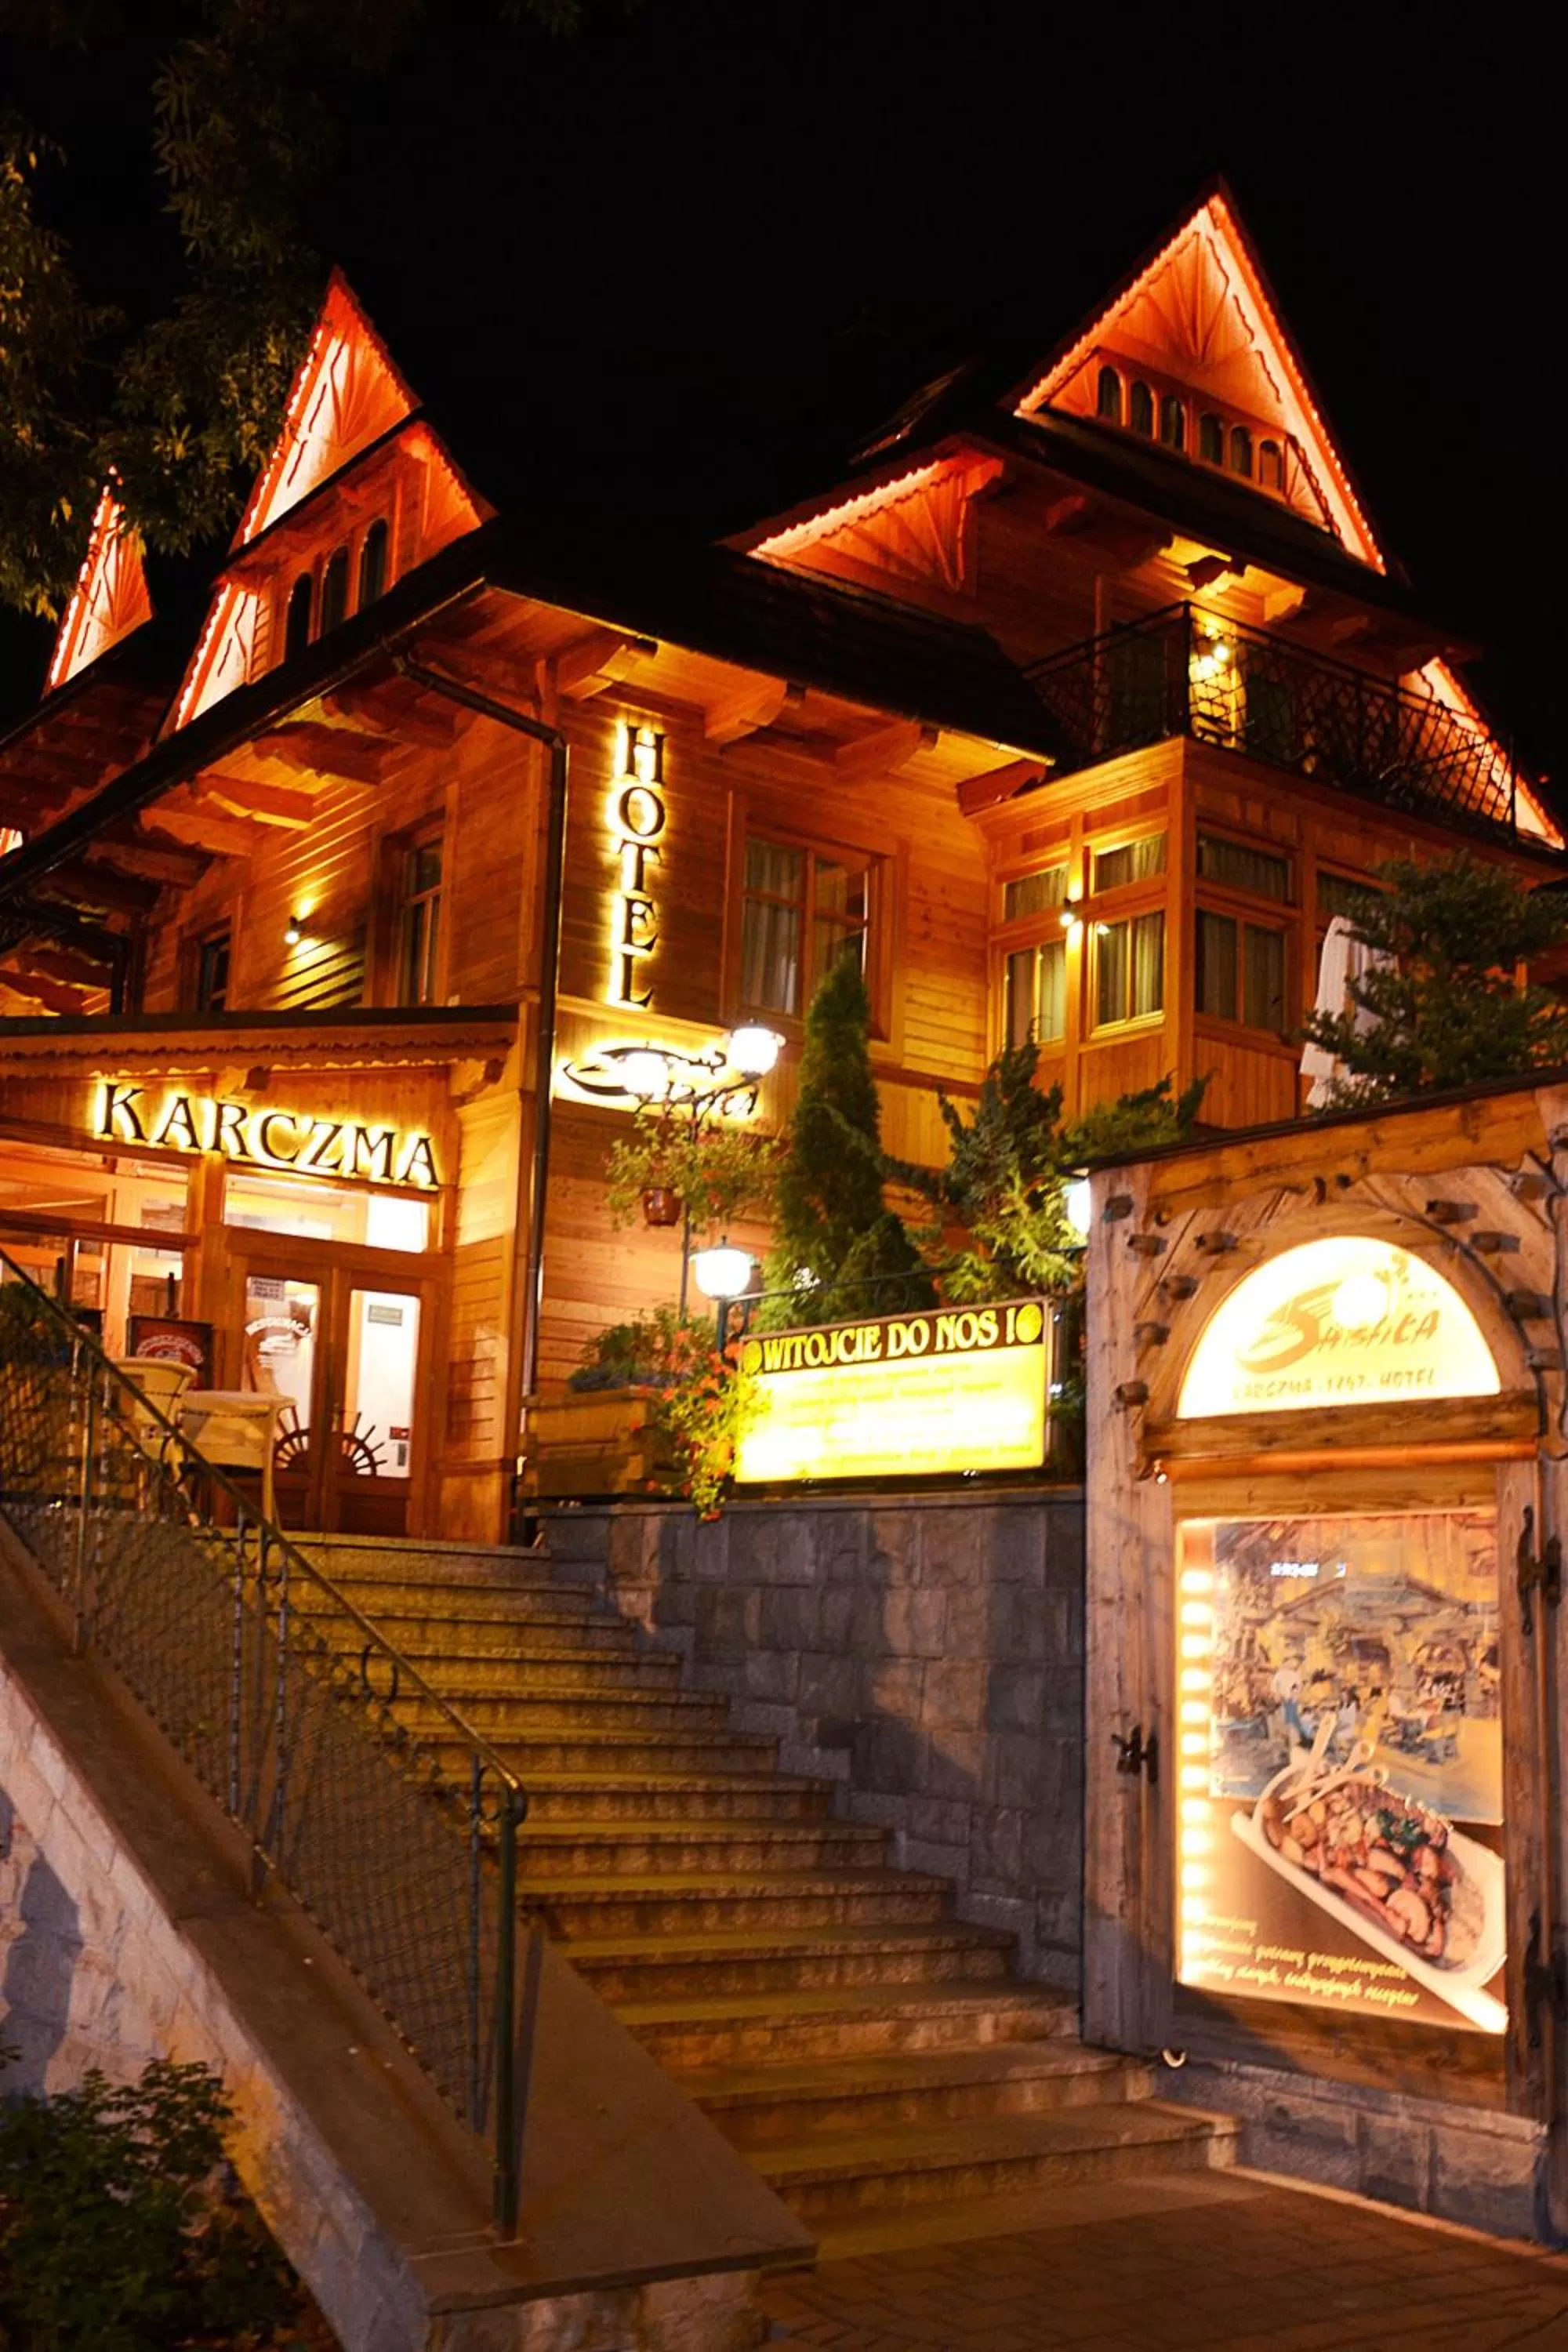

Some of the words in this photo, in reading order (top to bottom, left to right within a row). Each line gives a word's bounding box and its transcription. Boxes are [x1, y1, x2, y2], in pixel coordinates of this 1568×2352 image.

[617, 726, 667, 1009] HOTEL
[98, 1083, 439, 1186] KARCZMA
[762, 1325, 884, 1371] WITOJCIE
[887, 1318, 929, 1359] DO
[935, 1309, 998, 1352] NOS
